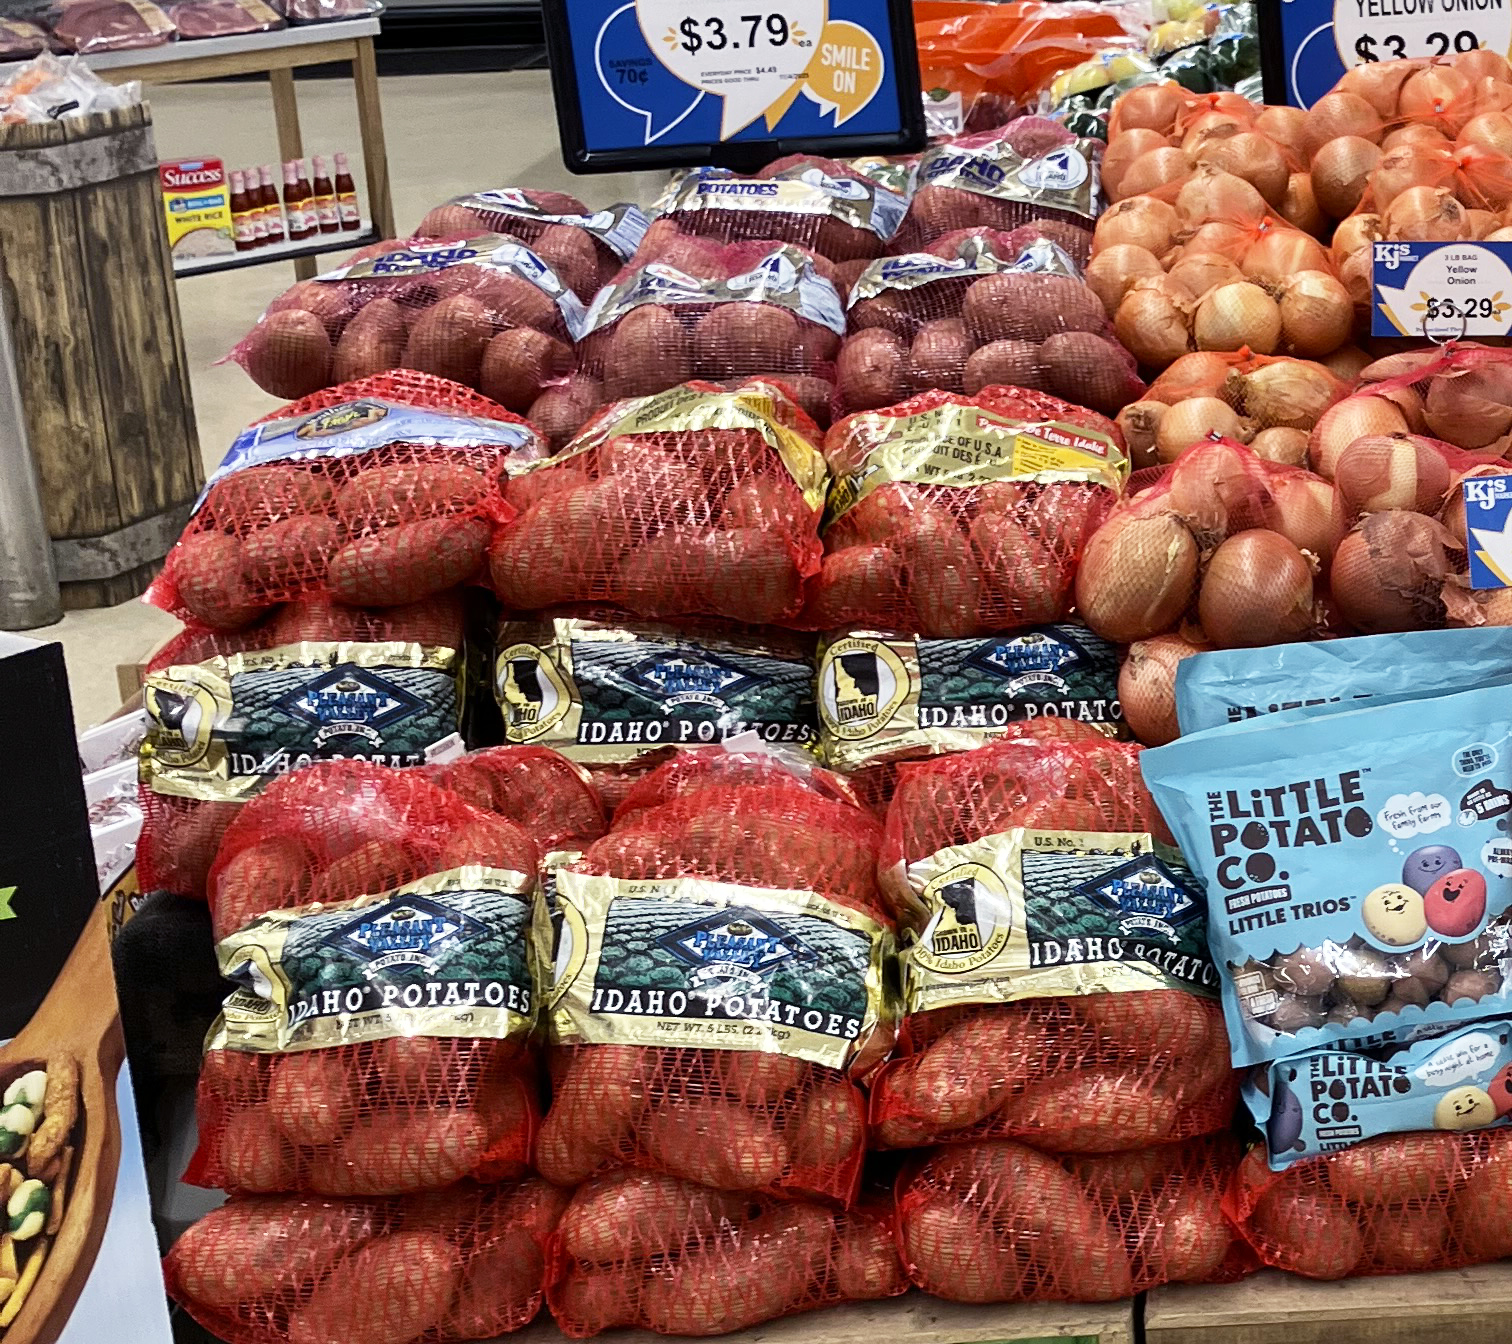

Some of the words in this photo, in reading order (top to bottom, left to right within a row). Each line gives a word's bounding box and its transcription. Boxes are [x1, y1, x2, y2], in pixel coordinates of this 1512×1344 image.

[678, 12, 790, 56] $3.79
[820, 42, 872, 72] SMILE
[615, 68, 649, 86] 70¢
[832, 69, 857, 95] ON
[163, 169, 223, 187] Success
[174, 214, 202, 224] WHITE
[204, 211, 223, 221] RICE
[1446, 265, 1478, 275] Yellow
[1446, 276, 1476, 285] Onion
[1426, 297, 1493, 321] $3.29
[839, 702, 876, 722] IDAHO
[920, 704, 1010, 728] IDAHO
[580, 720, 663, 743] IDAHO
[1206, 790, 1226, 823] THE
[1033, 836, 1055, 847] U.S.
[1056, 837, 1077, 847] No.
[1210, 805, 1374, 858] POTATO
[1217, 851, 1290, 890] CO.
[357, 915, 448, 939] PLEASANT
[1229, 909, 1288, 936] LITTLE
[1292, 898, 1352, 921] TRIOS
[935, 933, 979, 953] IDAHO
[1031, 937, 1124, 965] IDAHO
[287, 985, 363, 1029] IDAHO
[381, 980, 533, 1014] POTATOES
[591, 988, 687, 1016] IDAHO
[704, 994, 861, 1039] POTATOES
[656, 1020, 681, 1032] NET
[1310, 1075, 1412, 1103] POTATO
[1312, 1101, 1359, 1125] CO.
